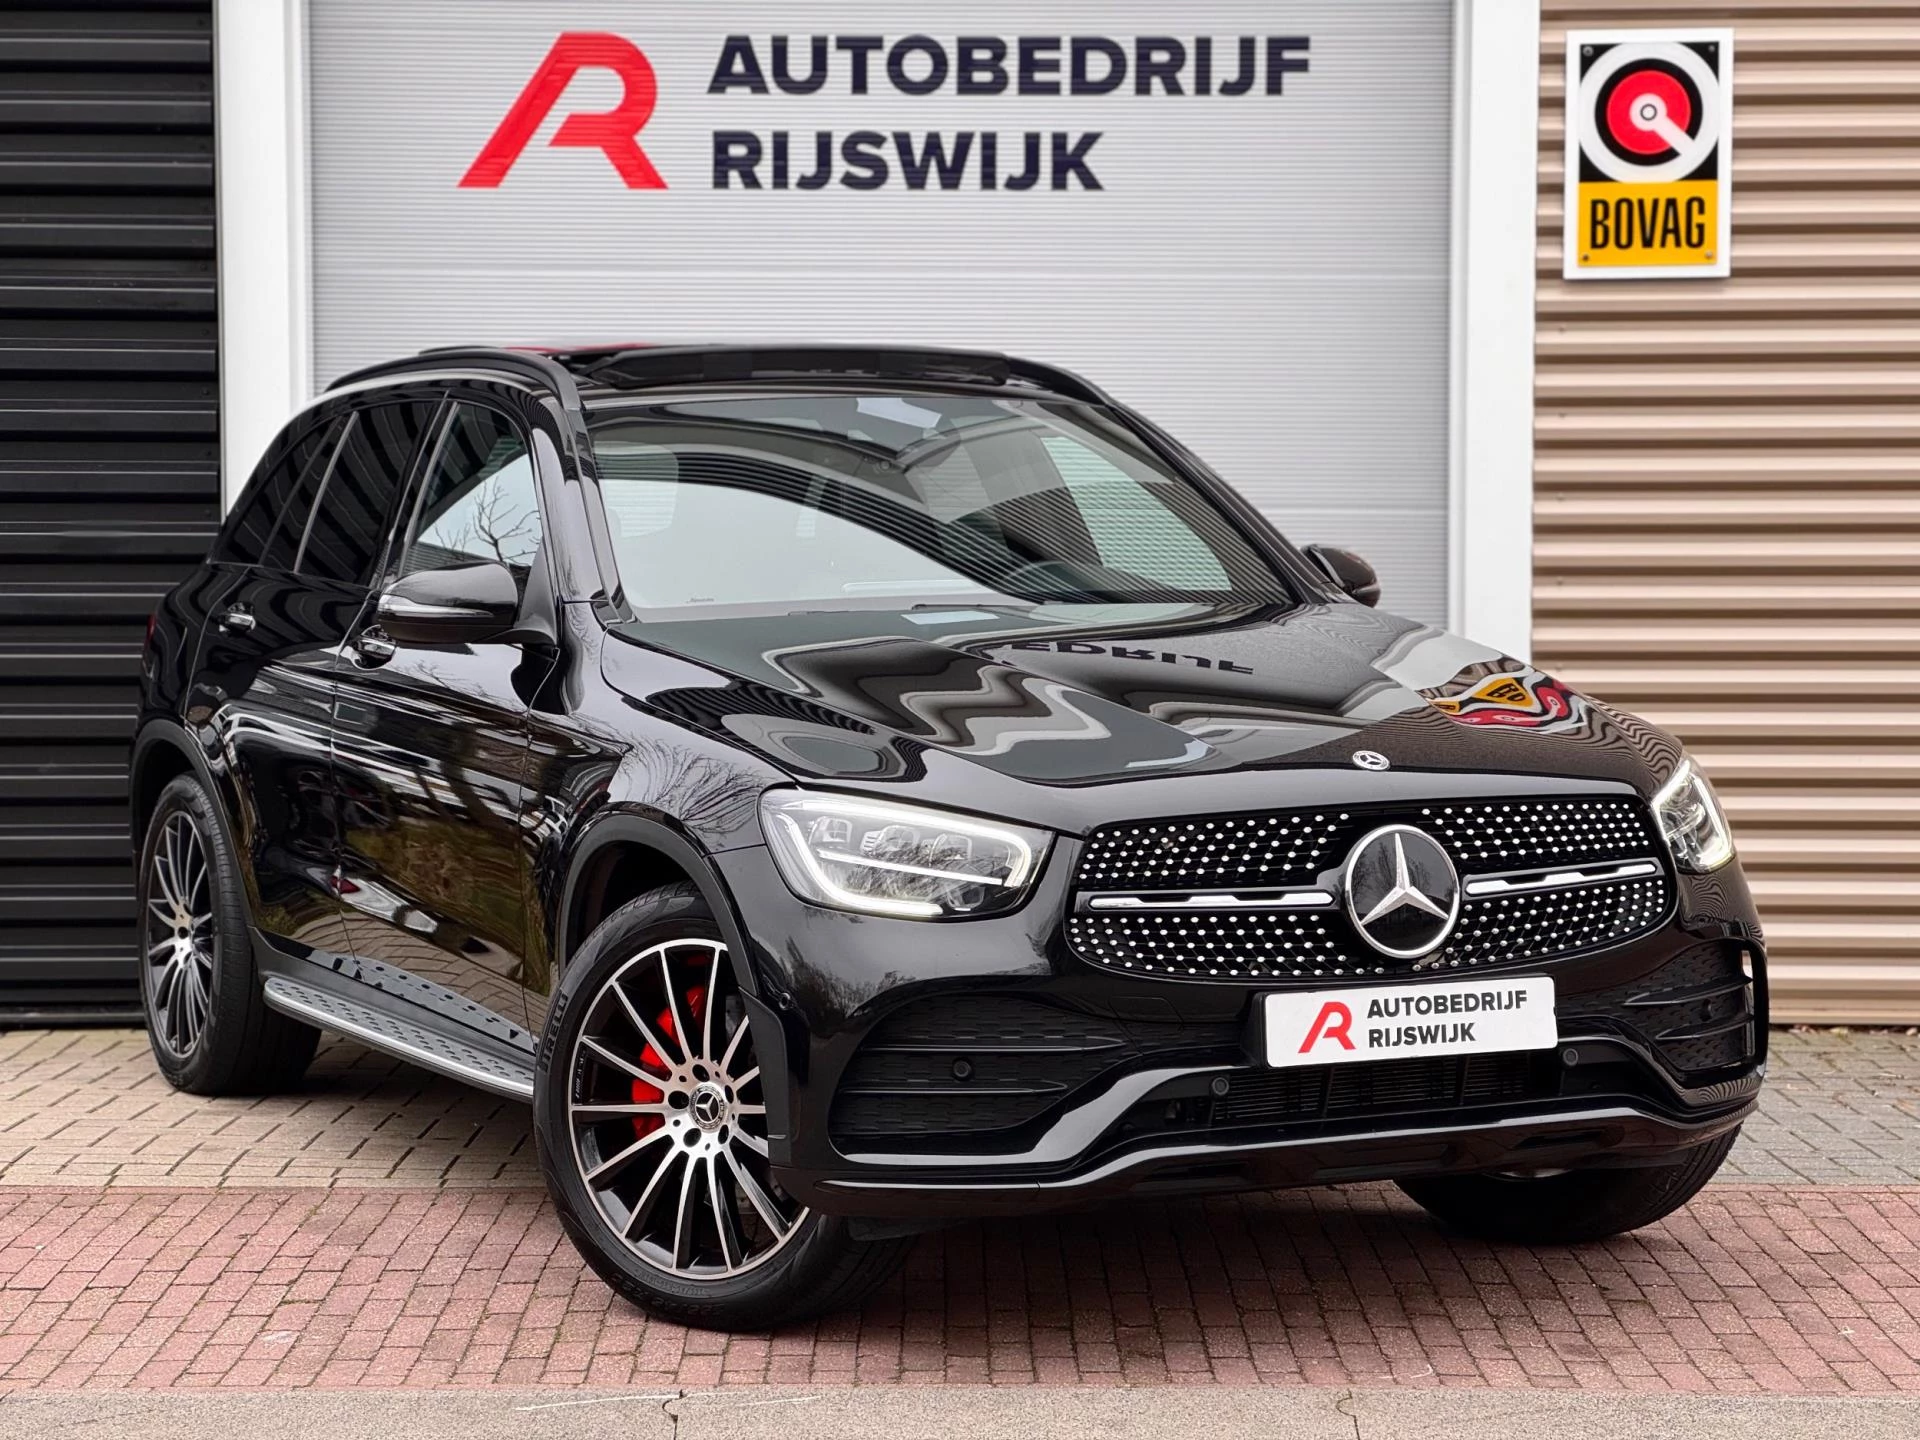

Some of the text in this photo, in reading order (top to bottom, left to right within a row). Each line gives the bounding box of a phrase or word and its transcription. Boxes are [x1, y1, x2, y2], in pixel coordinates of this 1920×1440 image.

[707, 35, 1311, 97] AUTOBEDRIJF
[712, 131, 1104, 191] RIJSWIJK
[1590, 196, 1706, 250] BOVAG
[1367, 989, 1528, 1019] AUTOBEDRIJF
[1368, 1022, 1476, 1049] RIJSWIJK
